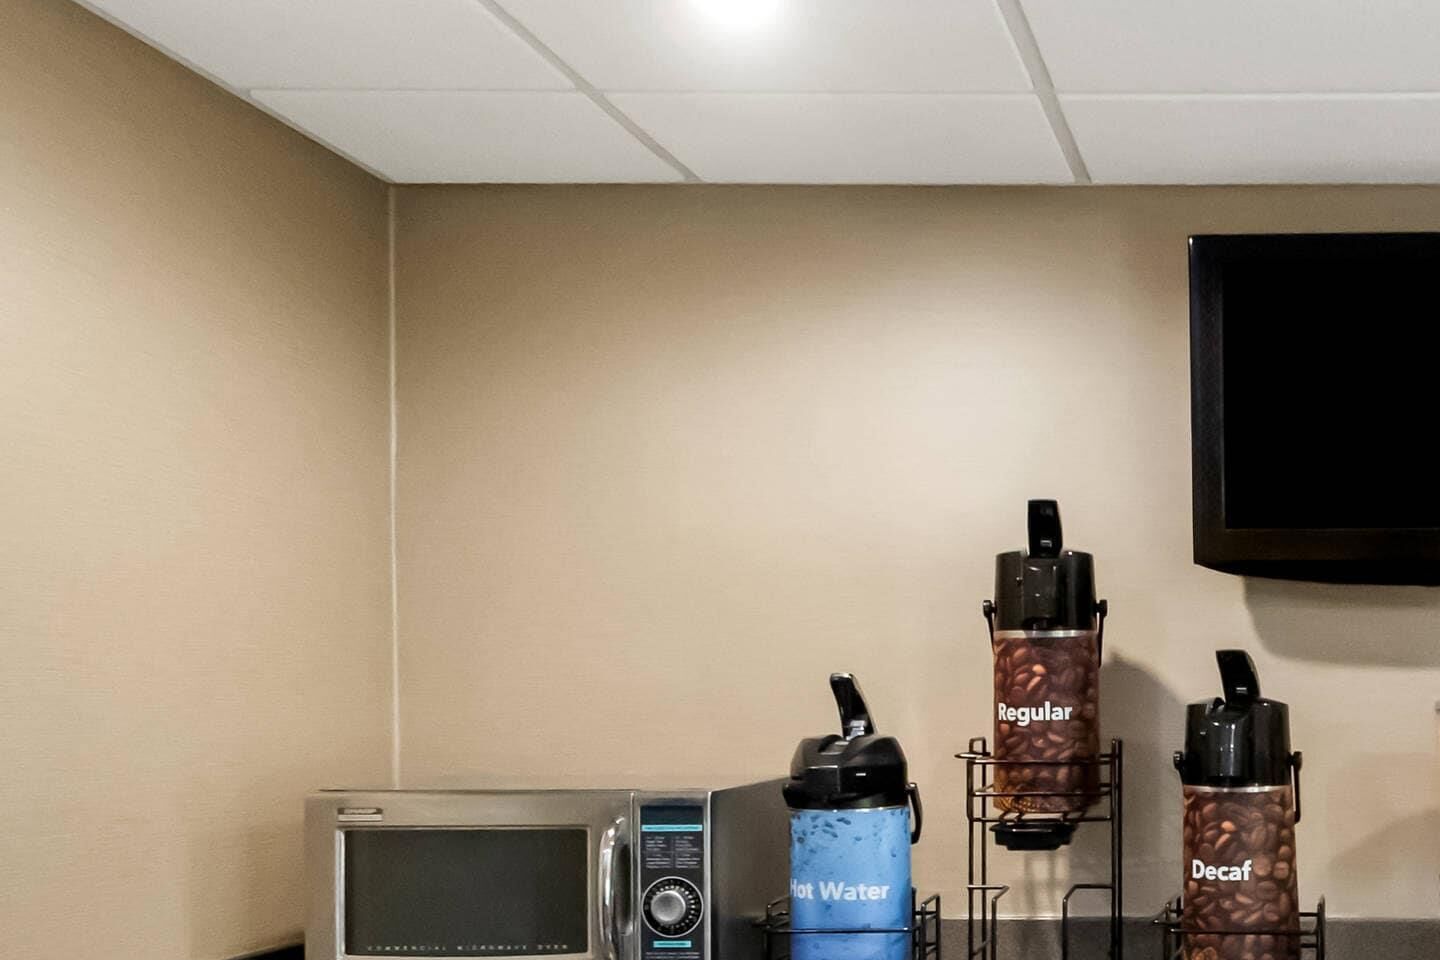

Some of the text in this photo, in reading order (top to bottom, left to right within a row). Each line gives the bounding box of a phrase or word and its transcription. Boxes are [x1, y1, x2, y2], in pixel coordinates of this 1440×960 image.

[998, 701, 1073, 727] Regular
[1192, 859, 1252, 881] Decaf
[790, 878, 890, 900] Hot Water
